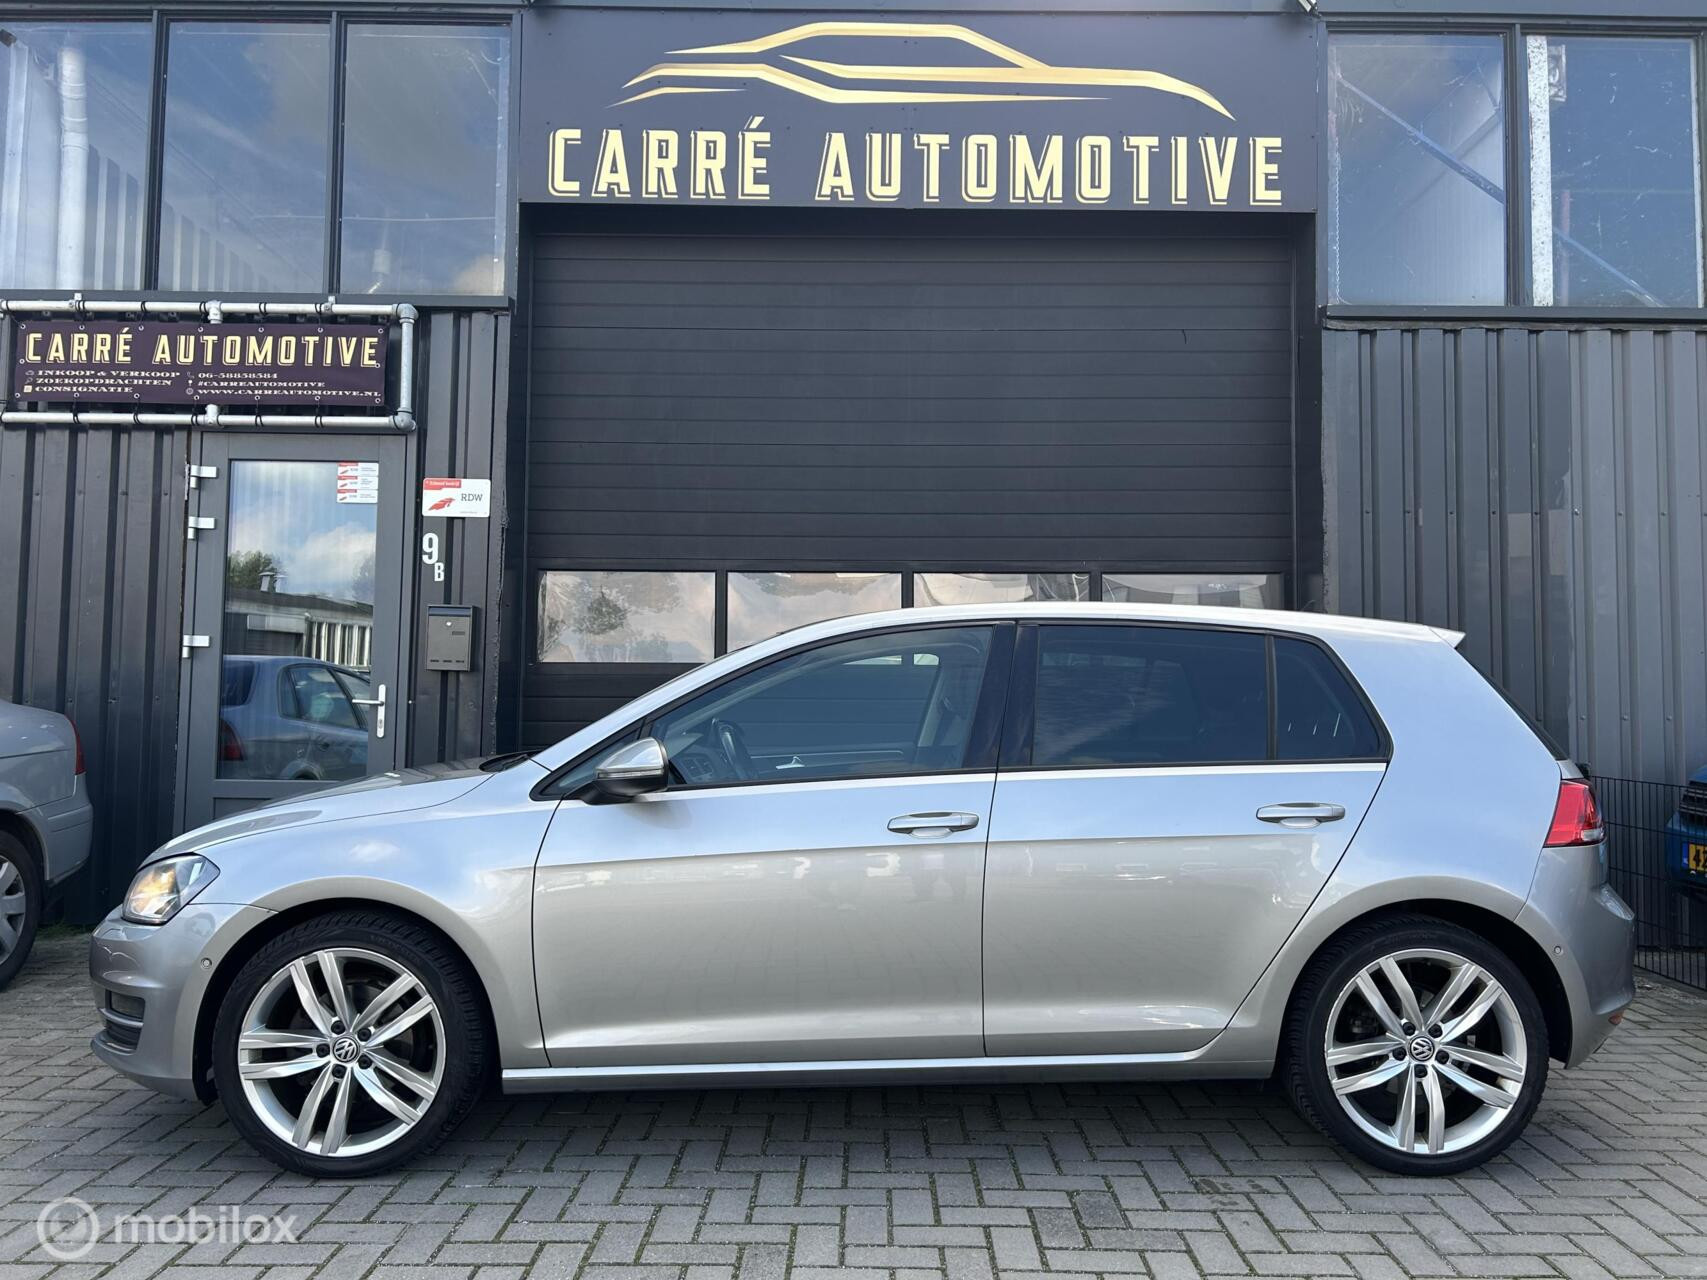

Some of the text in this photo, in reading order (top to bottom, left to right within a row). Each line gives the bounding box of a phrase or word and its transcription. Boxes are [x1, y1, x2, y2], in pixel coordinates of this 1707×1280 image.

[548, 116, 1283, 206] CARRÉ AUTOMOTIVE
[25, 327, 379, 368] CARRÉ AUTOMOTIVE
[35, 377, 172, 386] ZOEKOPDRACHTEN
[35, 385, 133, 393] CONSIGNATIE
[197, 388, 382, 397] WWW.CARREAUTOMOTIVE.NL
[461, 493, 483, 502] RDW
